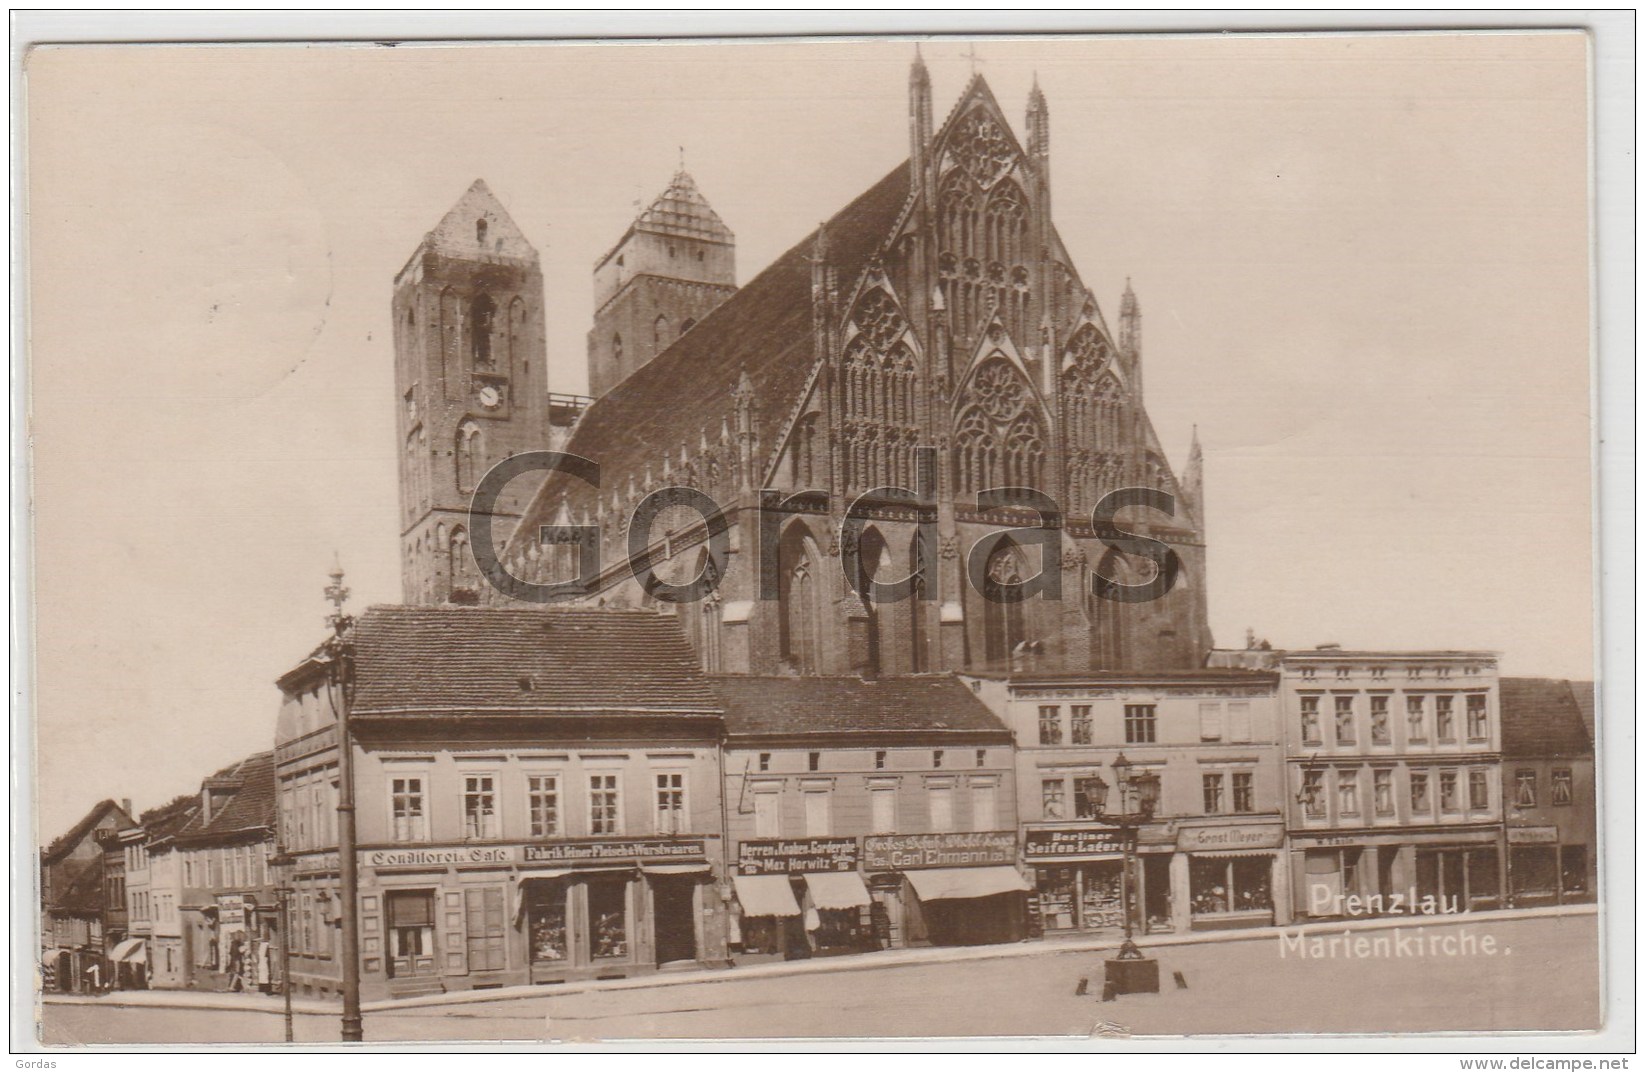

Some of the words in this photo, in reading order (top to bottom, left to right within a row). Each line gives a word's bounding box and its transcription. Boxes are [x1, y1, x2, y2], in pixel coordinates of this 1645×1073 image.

[1052, 832, 1112, 841] Berliner
[526, 846, 563, 860] Fabrik
[740, 842, 775, 856] Herren
[764, 858, 785, 871] Max
[788, 857, 830, 871] Horwitz
[892, 850, 923, 866] Carl
[926, 849, 988, 865] Ehmann
